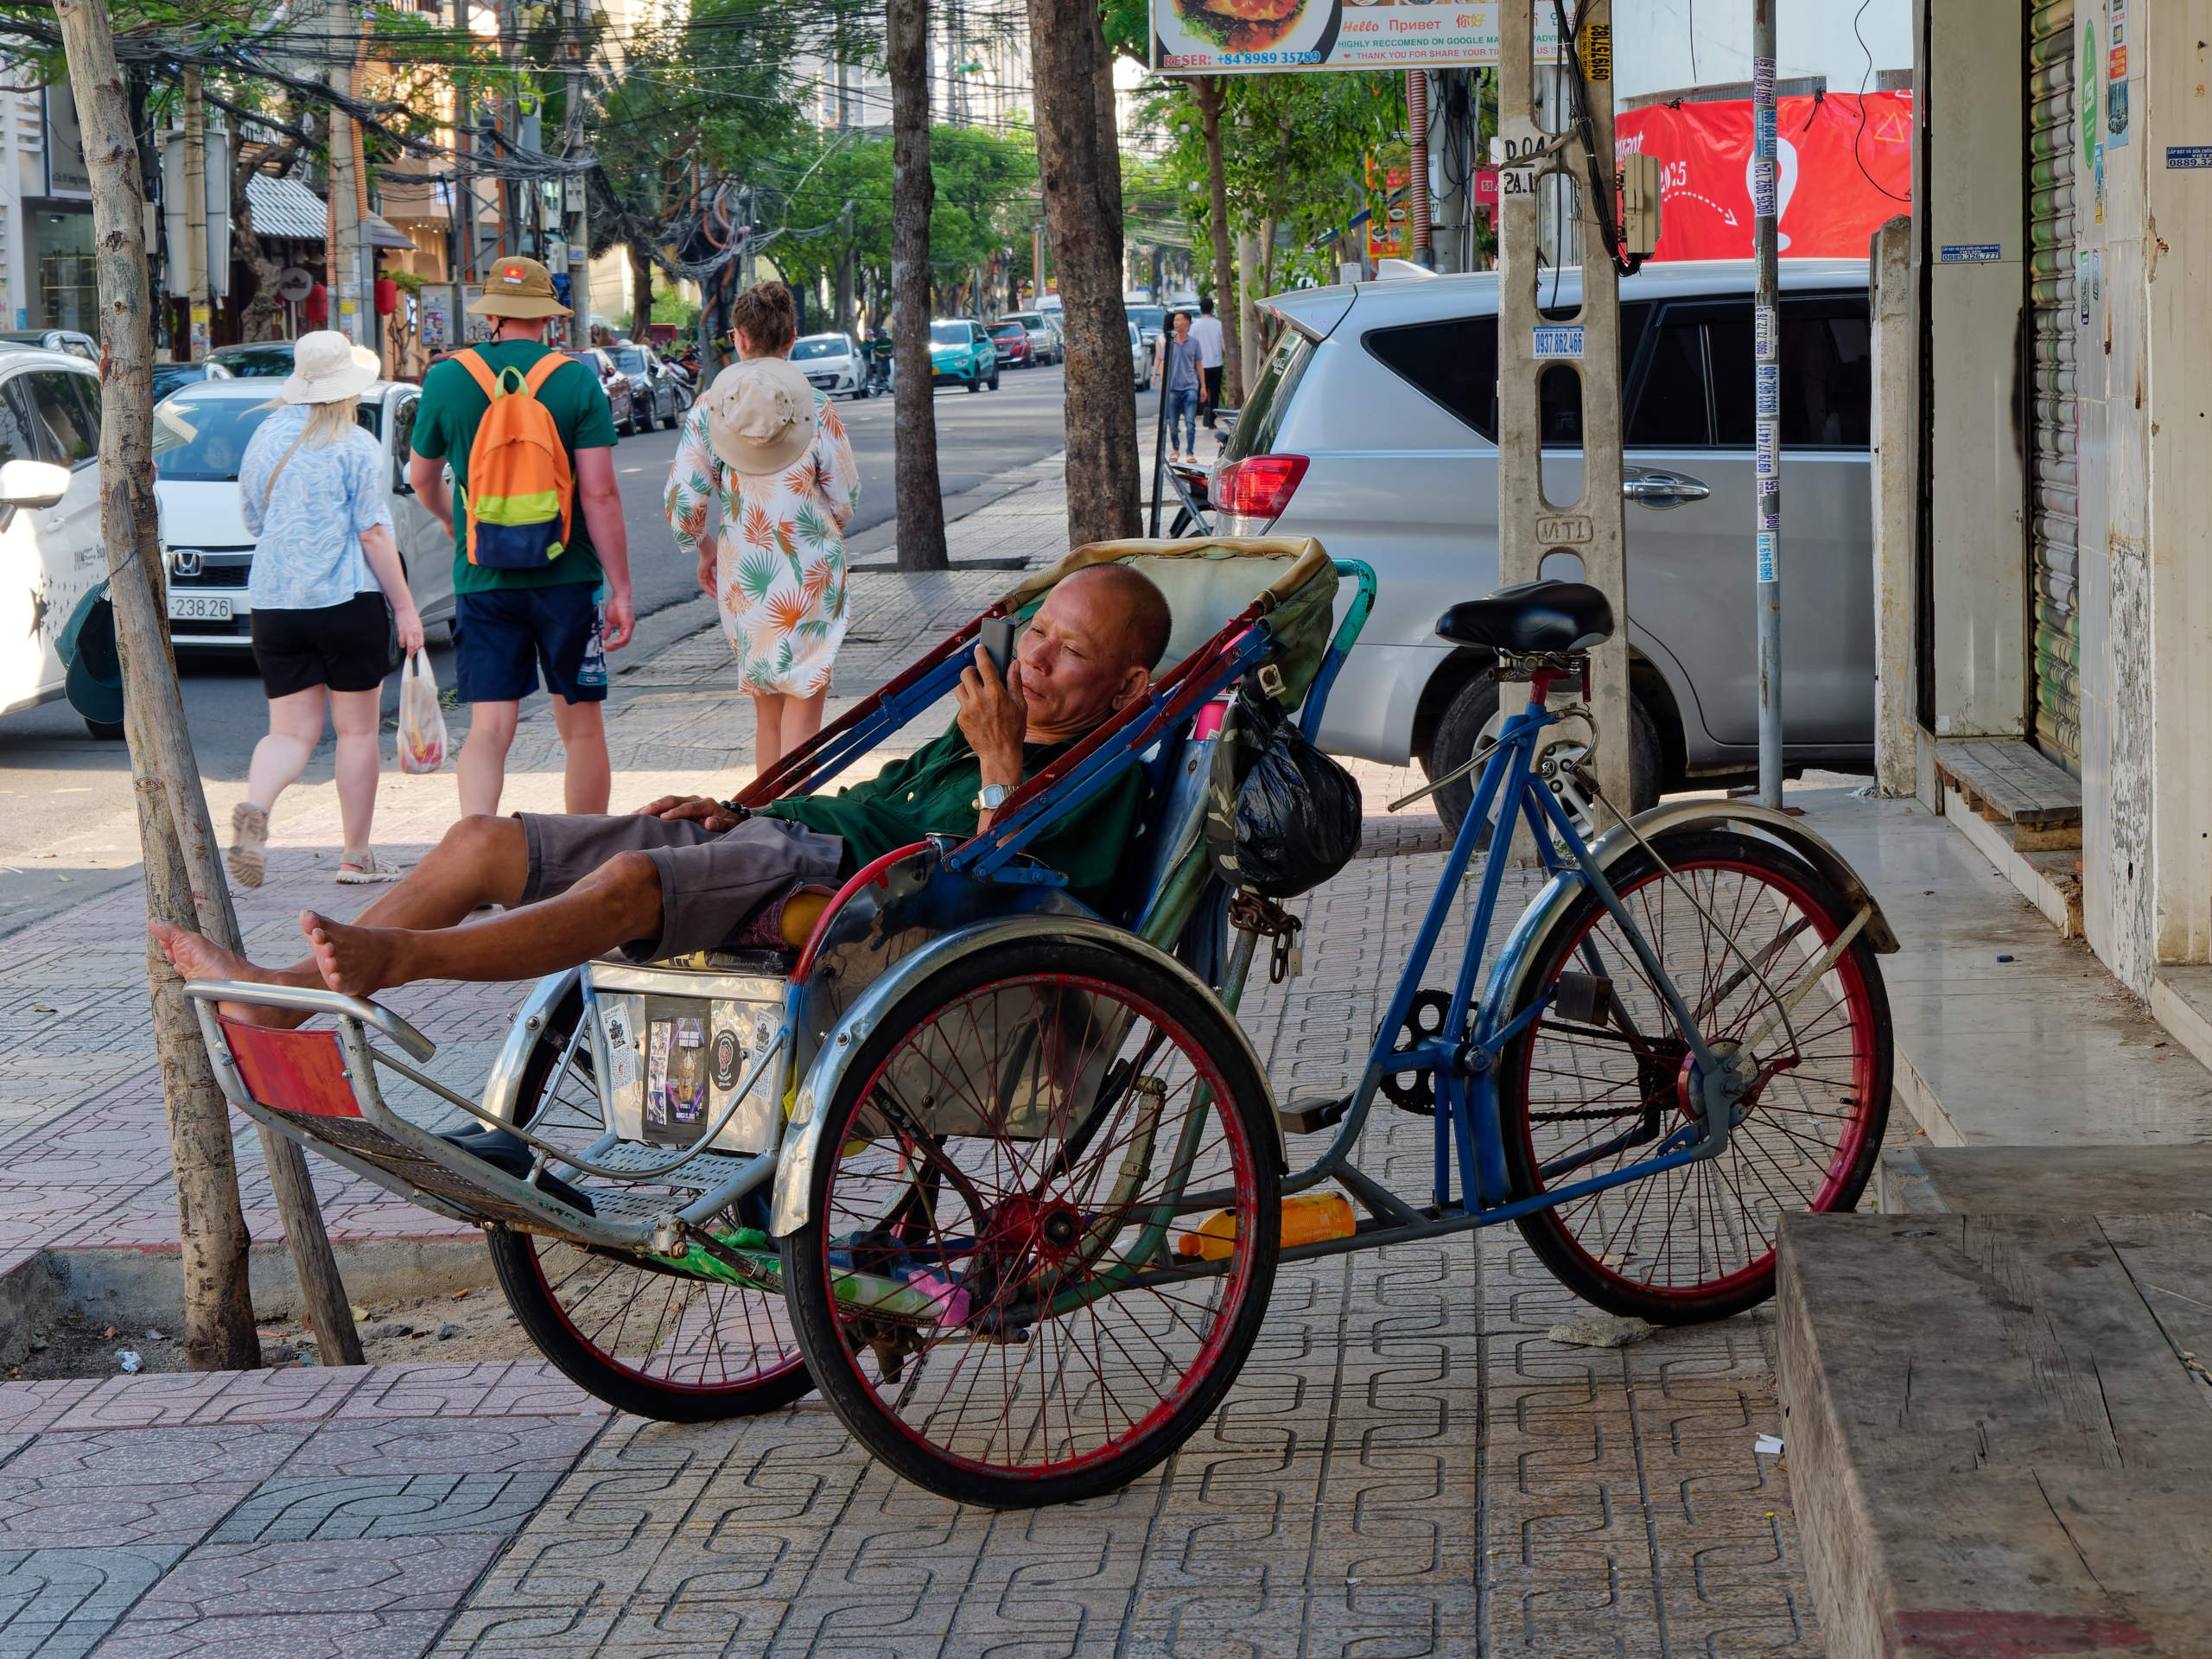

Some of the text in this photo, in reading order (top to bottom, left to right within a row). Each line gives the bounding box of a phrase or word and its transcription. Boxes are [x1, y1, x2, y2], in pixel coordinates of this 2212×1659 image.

[1343, 21, 1379, 32] Hello
[1389, 19, 1441, 33] Привет
[1456, 13, 1484, 29] 你好
[1373, 38, 1428, 47] RECCOMEND
[1446, 36, 1484, 45] GOOGLE
[1164, 50, 1320, 67] RESER: +84 8989 35789
